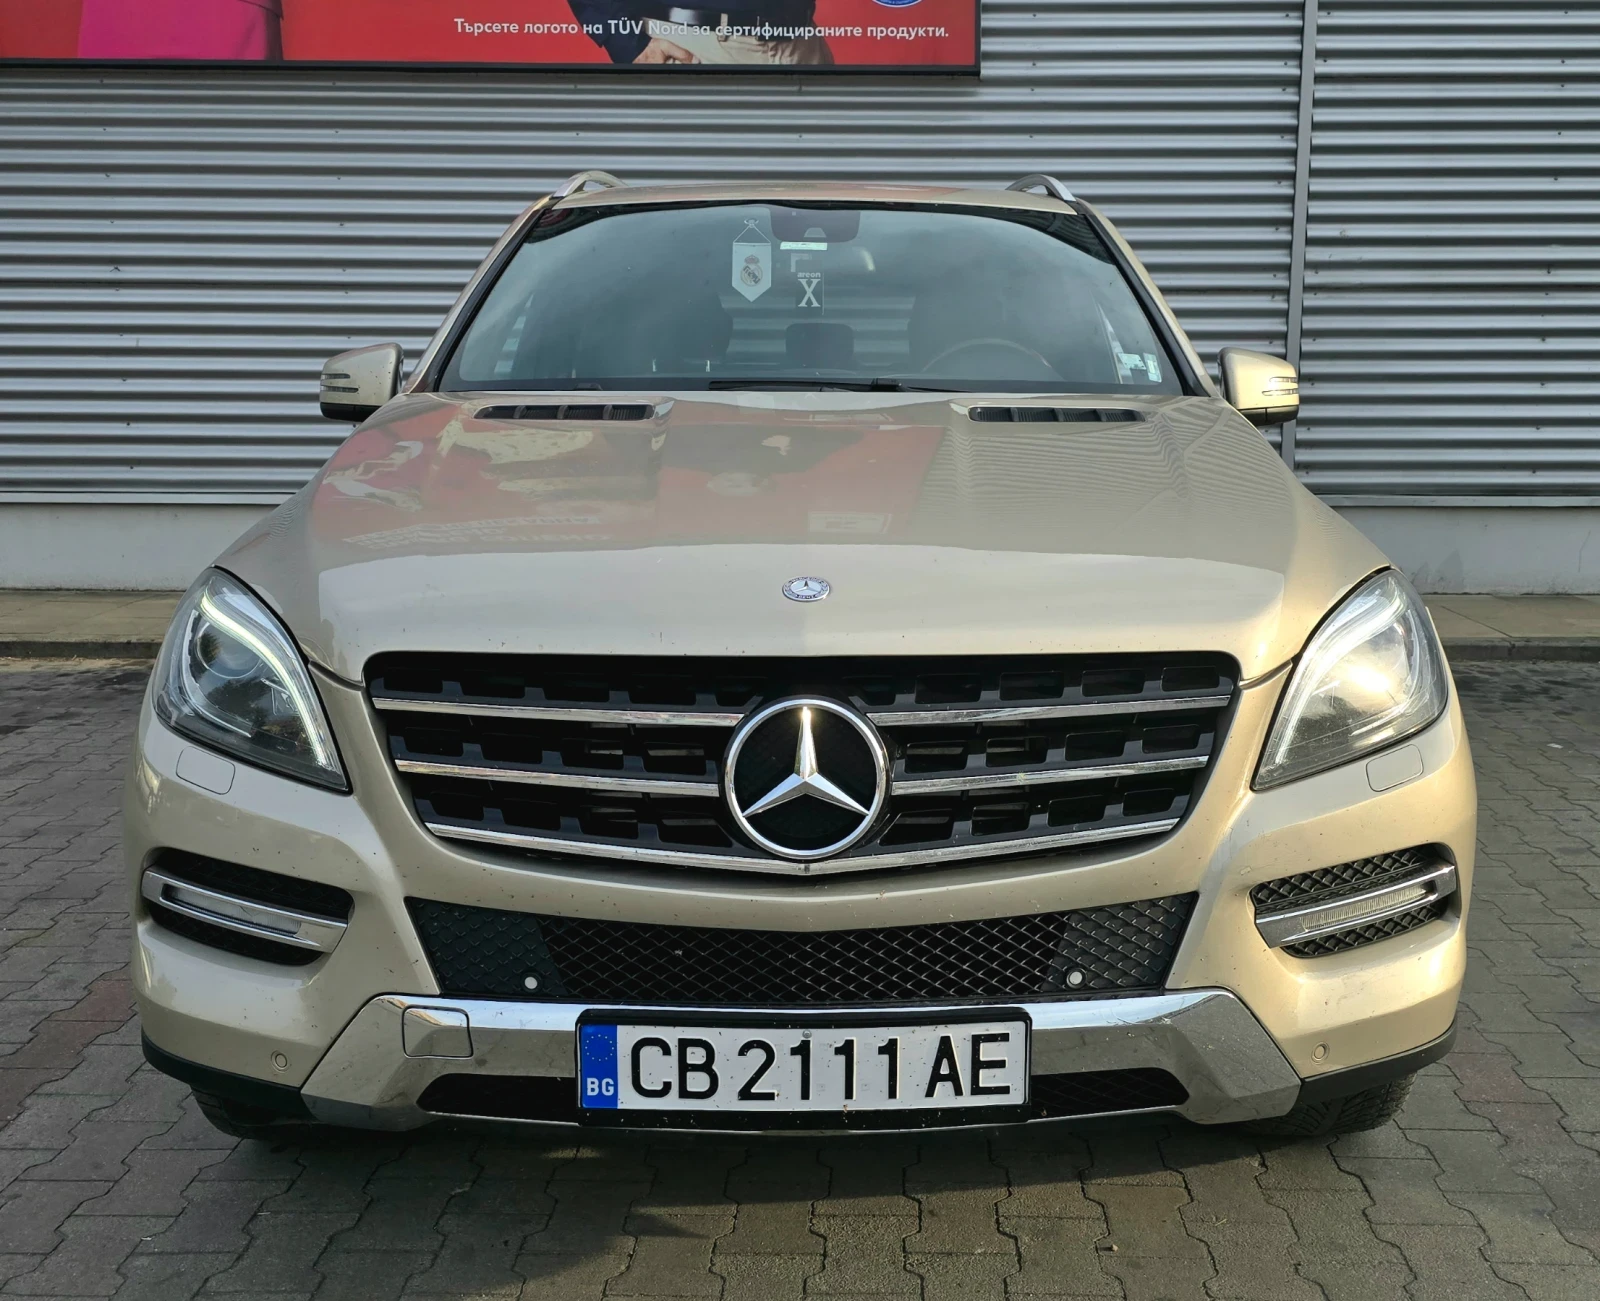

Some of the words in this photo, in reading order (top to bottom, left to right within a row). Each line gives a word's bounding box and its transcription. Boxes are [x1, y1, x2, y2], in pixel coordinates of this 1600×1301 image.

[453, 18, 519, 36] Търсете
[523, 21, 578, 34] логото
[583, 22, 603, 34] на
[607, 17, 643, 35] TÜV
[649, 19, 688, 35] Nord
[692, 23, 710, 36] за
[715, 22, 862, 40] сертифицираните
[867, 26, 949, 40] продукти.
[798, 279, 821, 307] X
[630, 1036, 719, 1100] CB
[737, 1037, 899, 1101] 2111
[924, 1032, 1011, 1098] AE
[586, 1077, 615, 1096] BG
